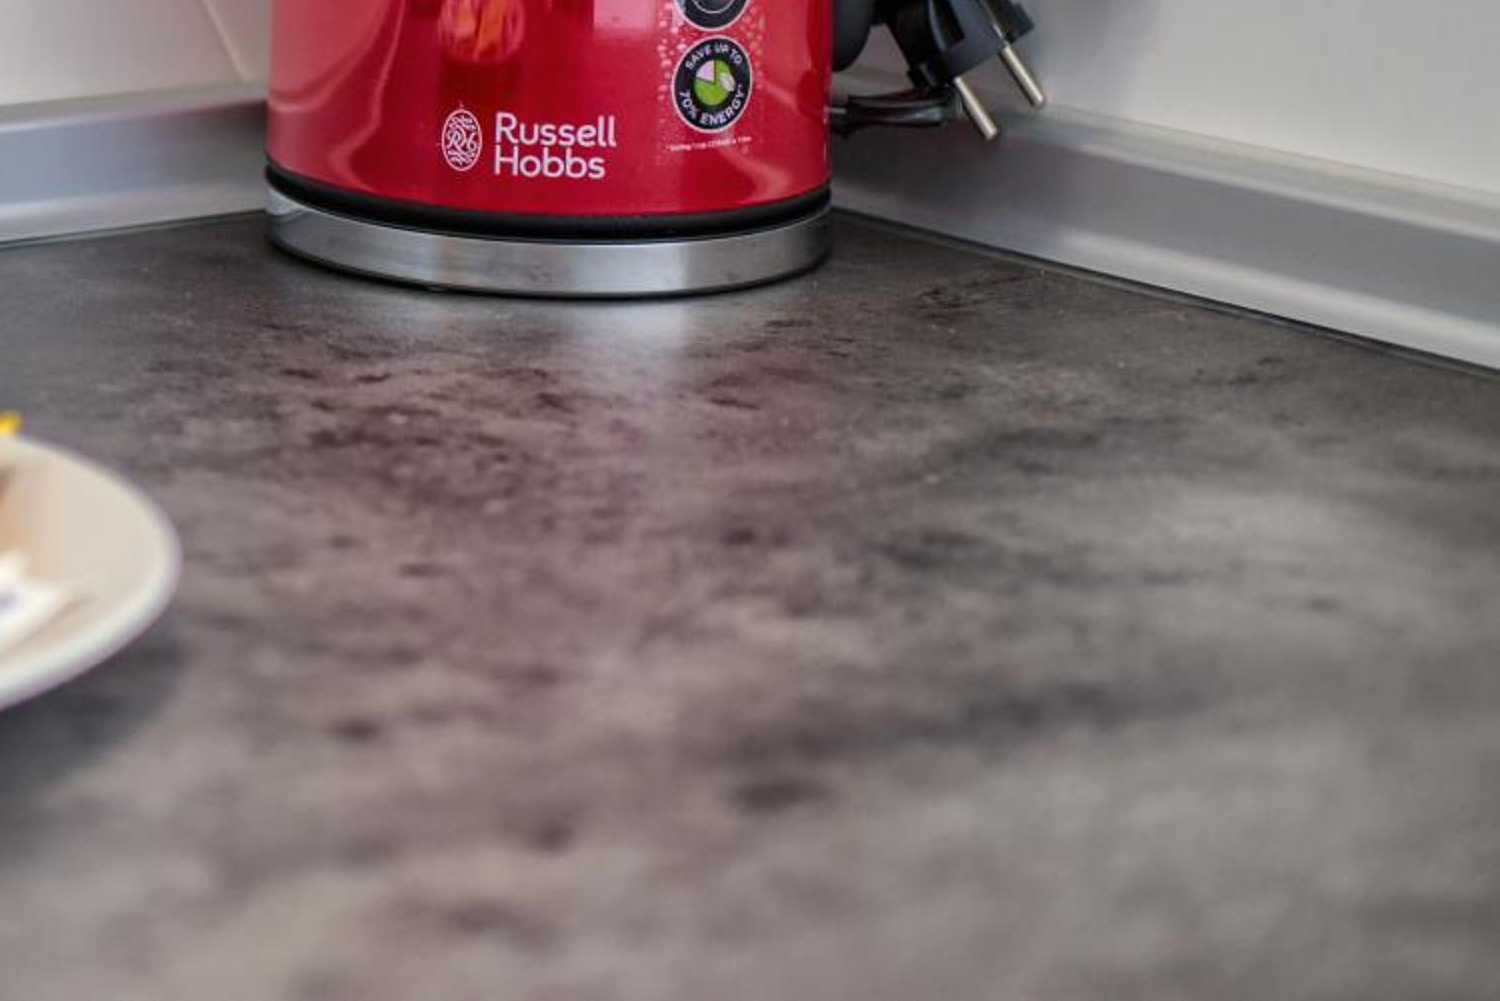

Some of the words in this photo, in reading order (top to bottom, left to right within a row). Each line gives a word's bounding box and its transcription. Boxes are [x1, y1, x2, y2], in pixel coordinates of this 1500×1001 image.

[685, 45, 712, 70] SAVE
[714, 42, 729, 54] UP
[729, 48, 743, 65] TO
[494, 110, 618, 148] Russell
[494, 145, 607, 179] Hobbs
